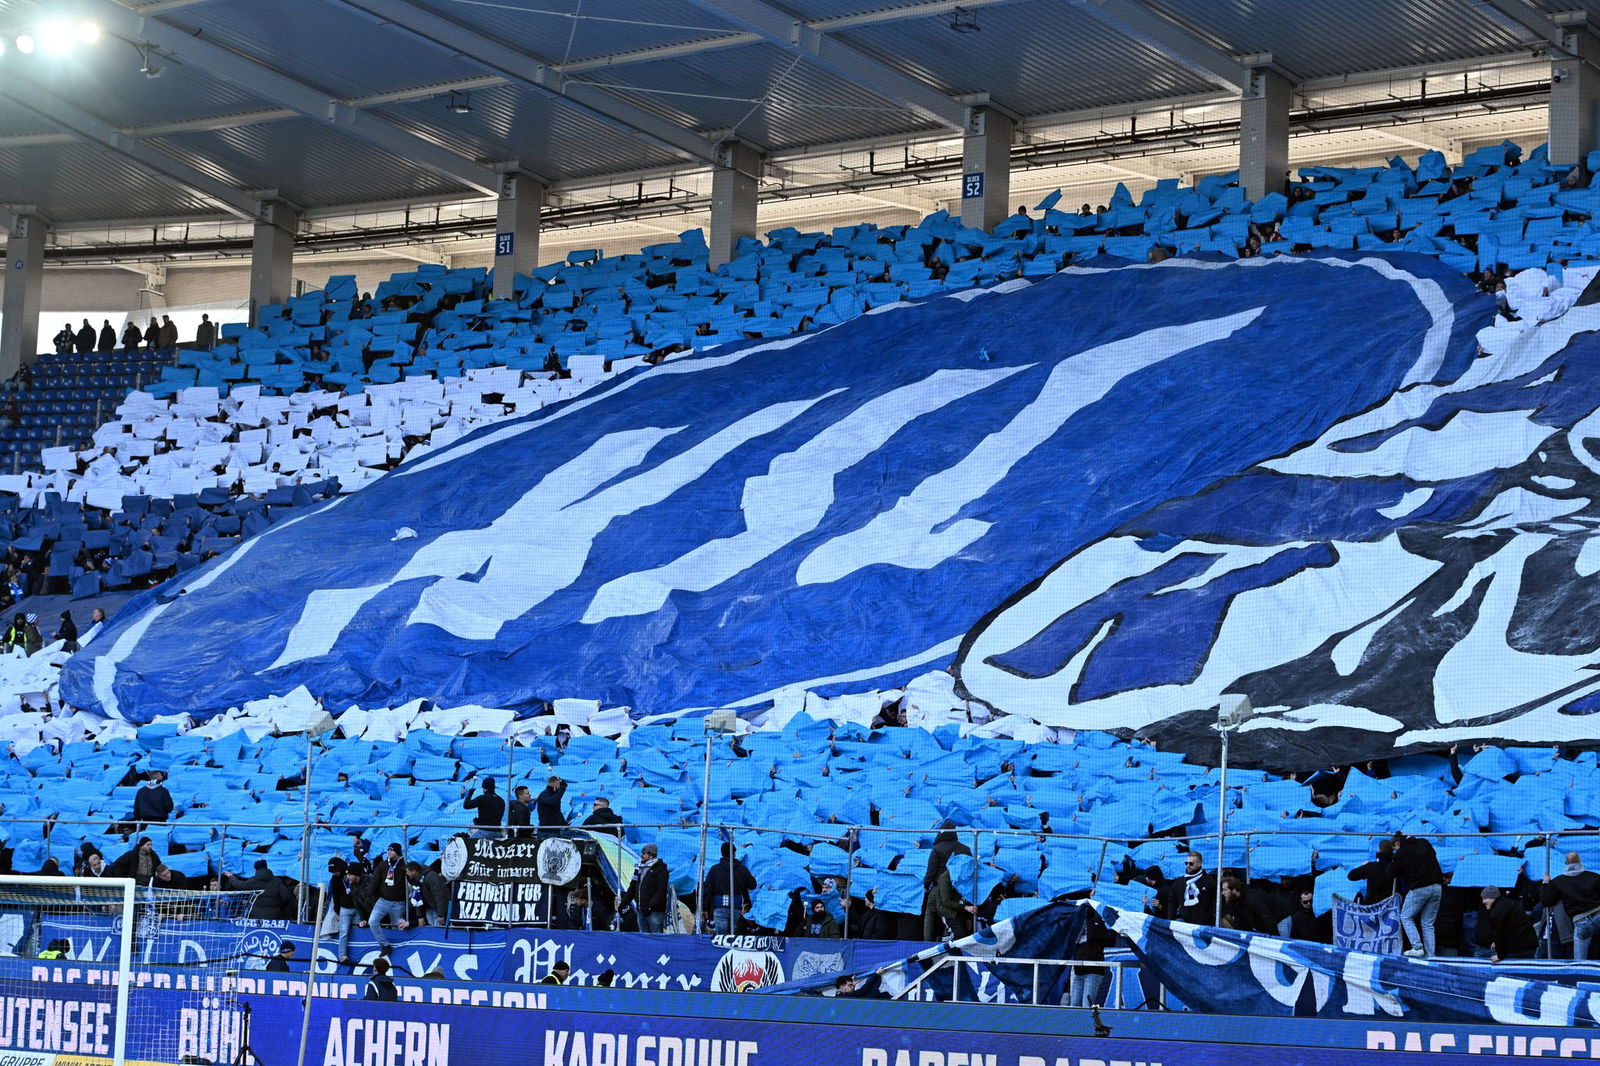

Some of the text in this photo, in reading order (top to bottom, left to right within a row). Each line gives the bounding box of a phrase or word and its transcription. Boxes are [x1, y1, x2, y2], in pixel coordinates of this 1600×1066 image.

[966, 175, 980, 183] BLOCK
[474, 838, 536, 859] Moser
[457, 881, 542, 903] FREIHEIT FÜR
[491, 902, 520, 922] UND
[1336, 908, 1400, 938] UNS
[240, 936, 260, 954] ILD
[711, 934, 756, 950] ACAB
[323, 1016, 451, 1066] ACHERN
